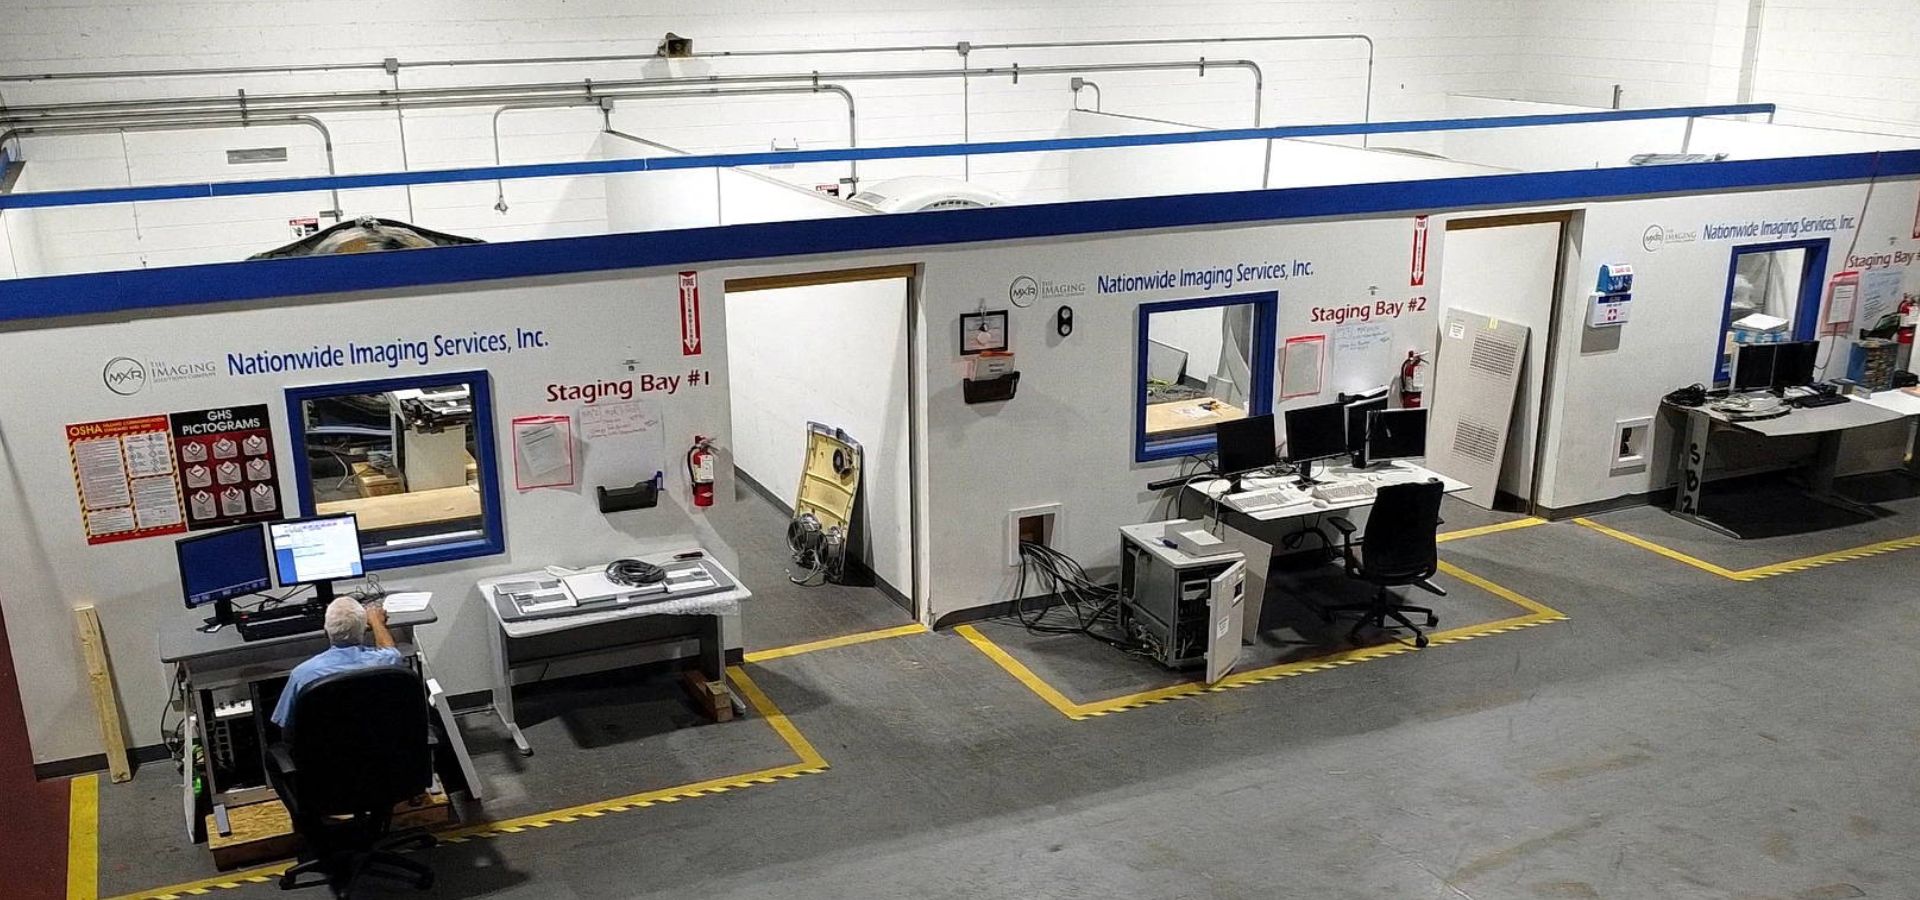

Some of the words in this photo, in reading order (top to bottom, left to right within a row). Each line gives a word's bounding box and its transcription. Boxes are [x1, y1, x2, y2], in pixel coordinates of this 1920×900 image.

[1703, 221, 1759, 240] Nationwide
[1760, 217, 1799, 238] Imaging
[1847, 252, 1891, 270] Staging
[1894, 250, 1915, 266] Bay
[1097, 270, 1176, 294] Nationwide
[1180, 266, 1233, 290] Imaging
[1236, 261, 1289, 281] Services,
[1292, 259, 1314, 277] Inc.
[1042, 283, 1086, 295] IMAGING
[1311, 303, 1371, 324] Staging
[1375, 300, 1404, 318] Bay
[1408, 296, 1427, 312] #2
[228, 345, 344, 376] Nationwide
[350, 338, 428, 368] Imaging
[434, 331, 512, 356] Services,
[517, 327, 549, 349] Inc.
[109, 367, 144, 385] MXR
[151, 361, 216, 378] IMAGING
[546, 379, 633, 403] Staging
[641, 374, 681, 394] Bay
[688, 370, 710, 387] #1
[207, 409, 233, 421] GHS
[69, 425, 103, 437] OSHA
[182, 418, 260, 435] PICTOGRAMS
